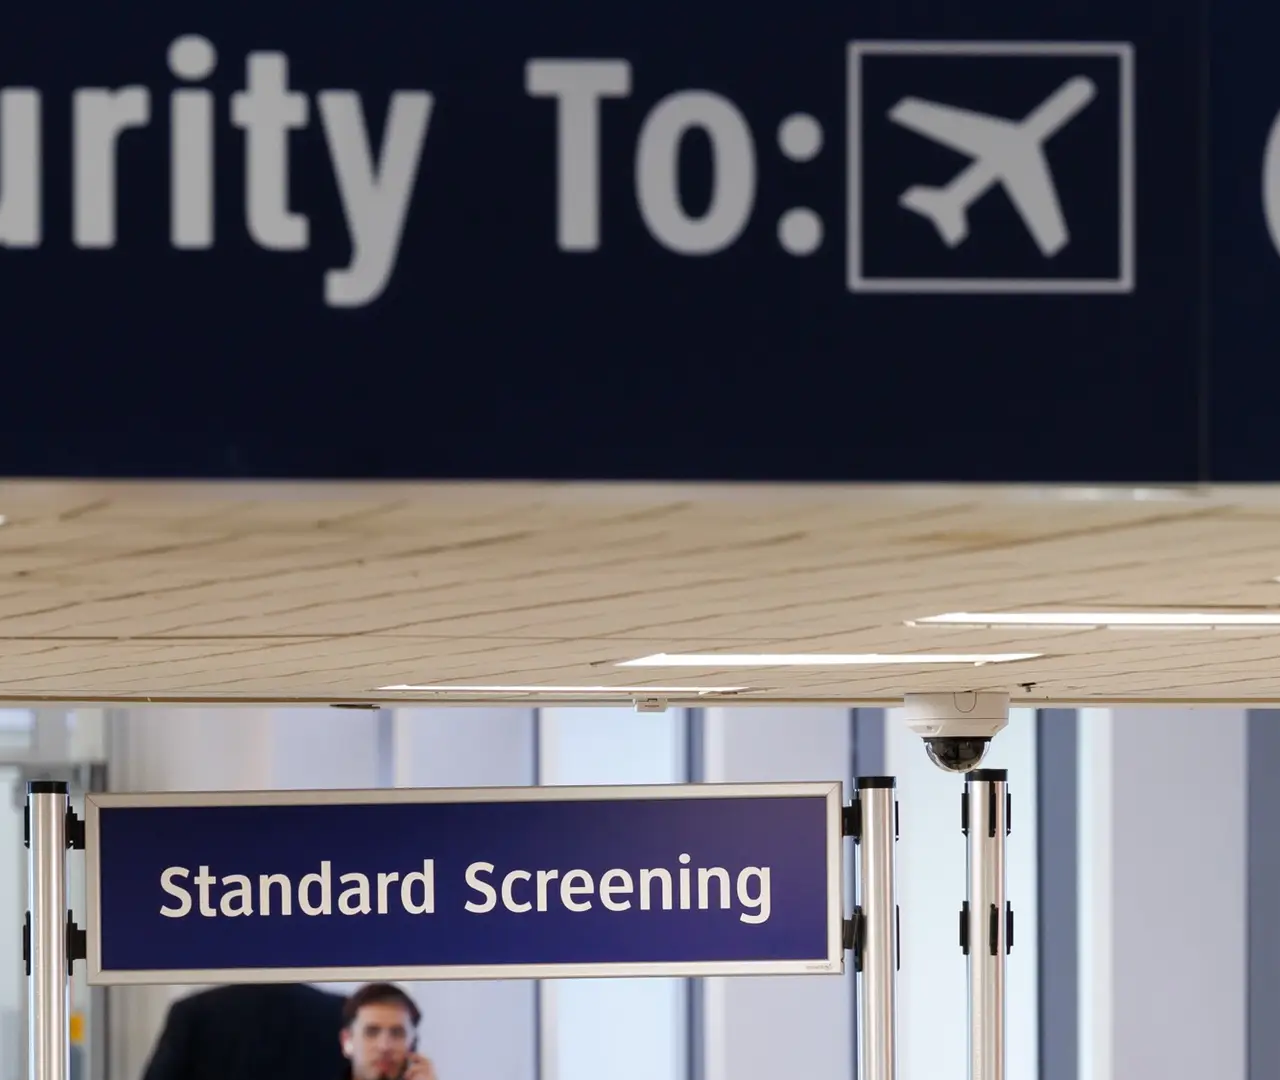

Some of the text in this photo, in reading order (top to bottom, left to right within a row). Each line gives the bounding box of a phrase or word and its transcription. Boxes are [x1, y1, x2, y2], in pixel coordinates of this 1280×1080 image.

[527, 60, 822, 254] To:
[158, 853, 772, 925] Standard Screening
